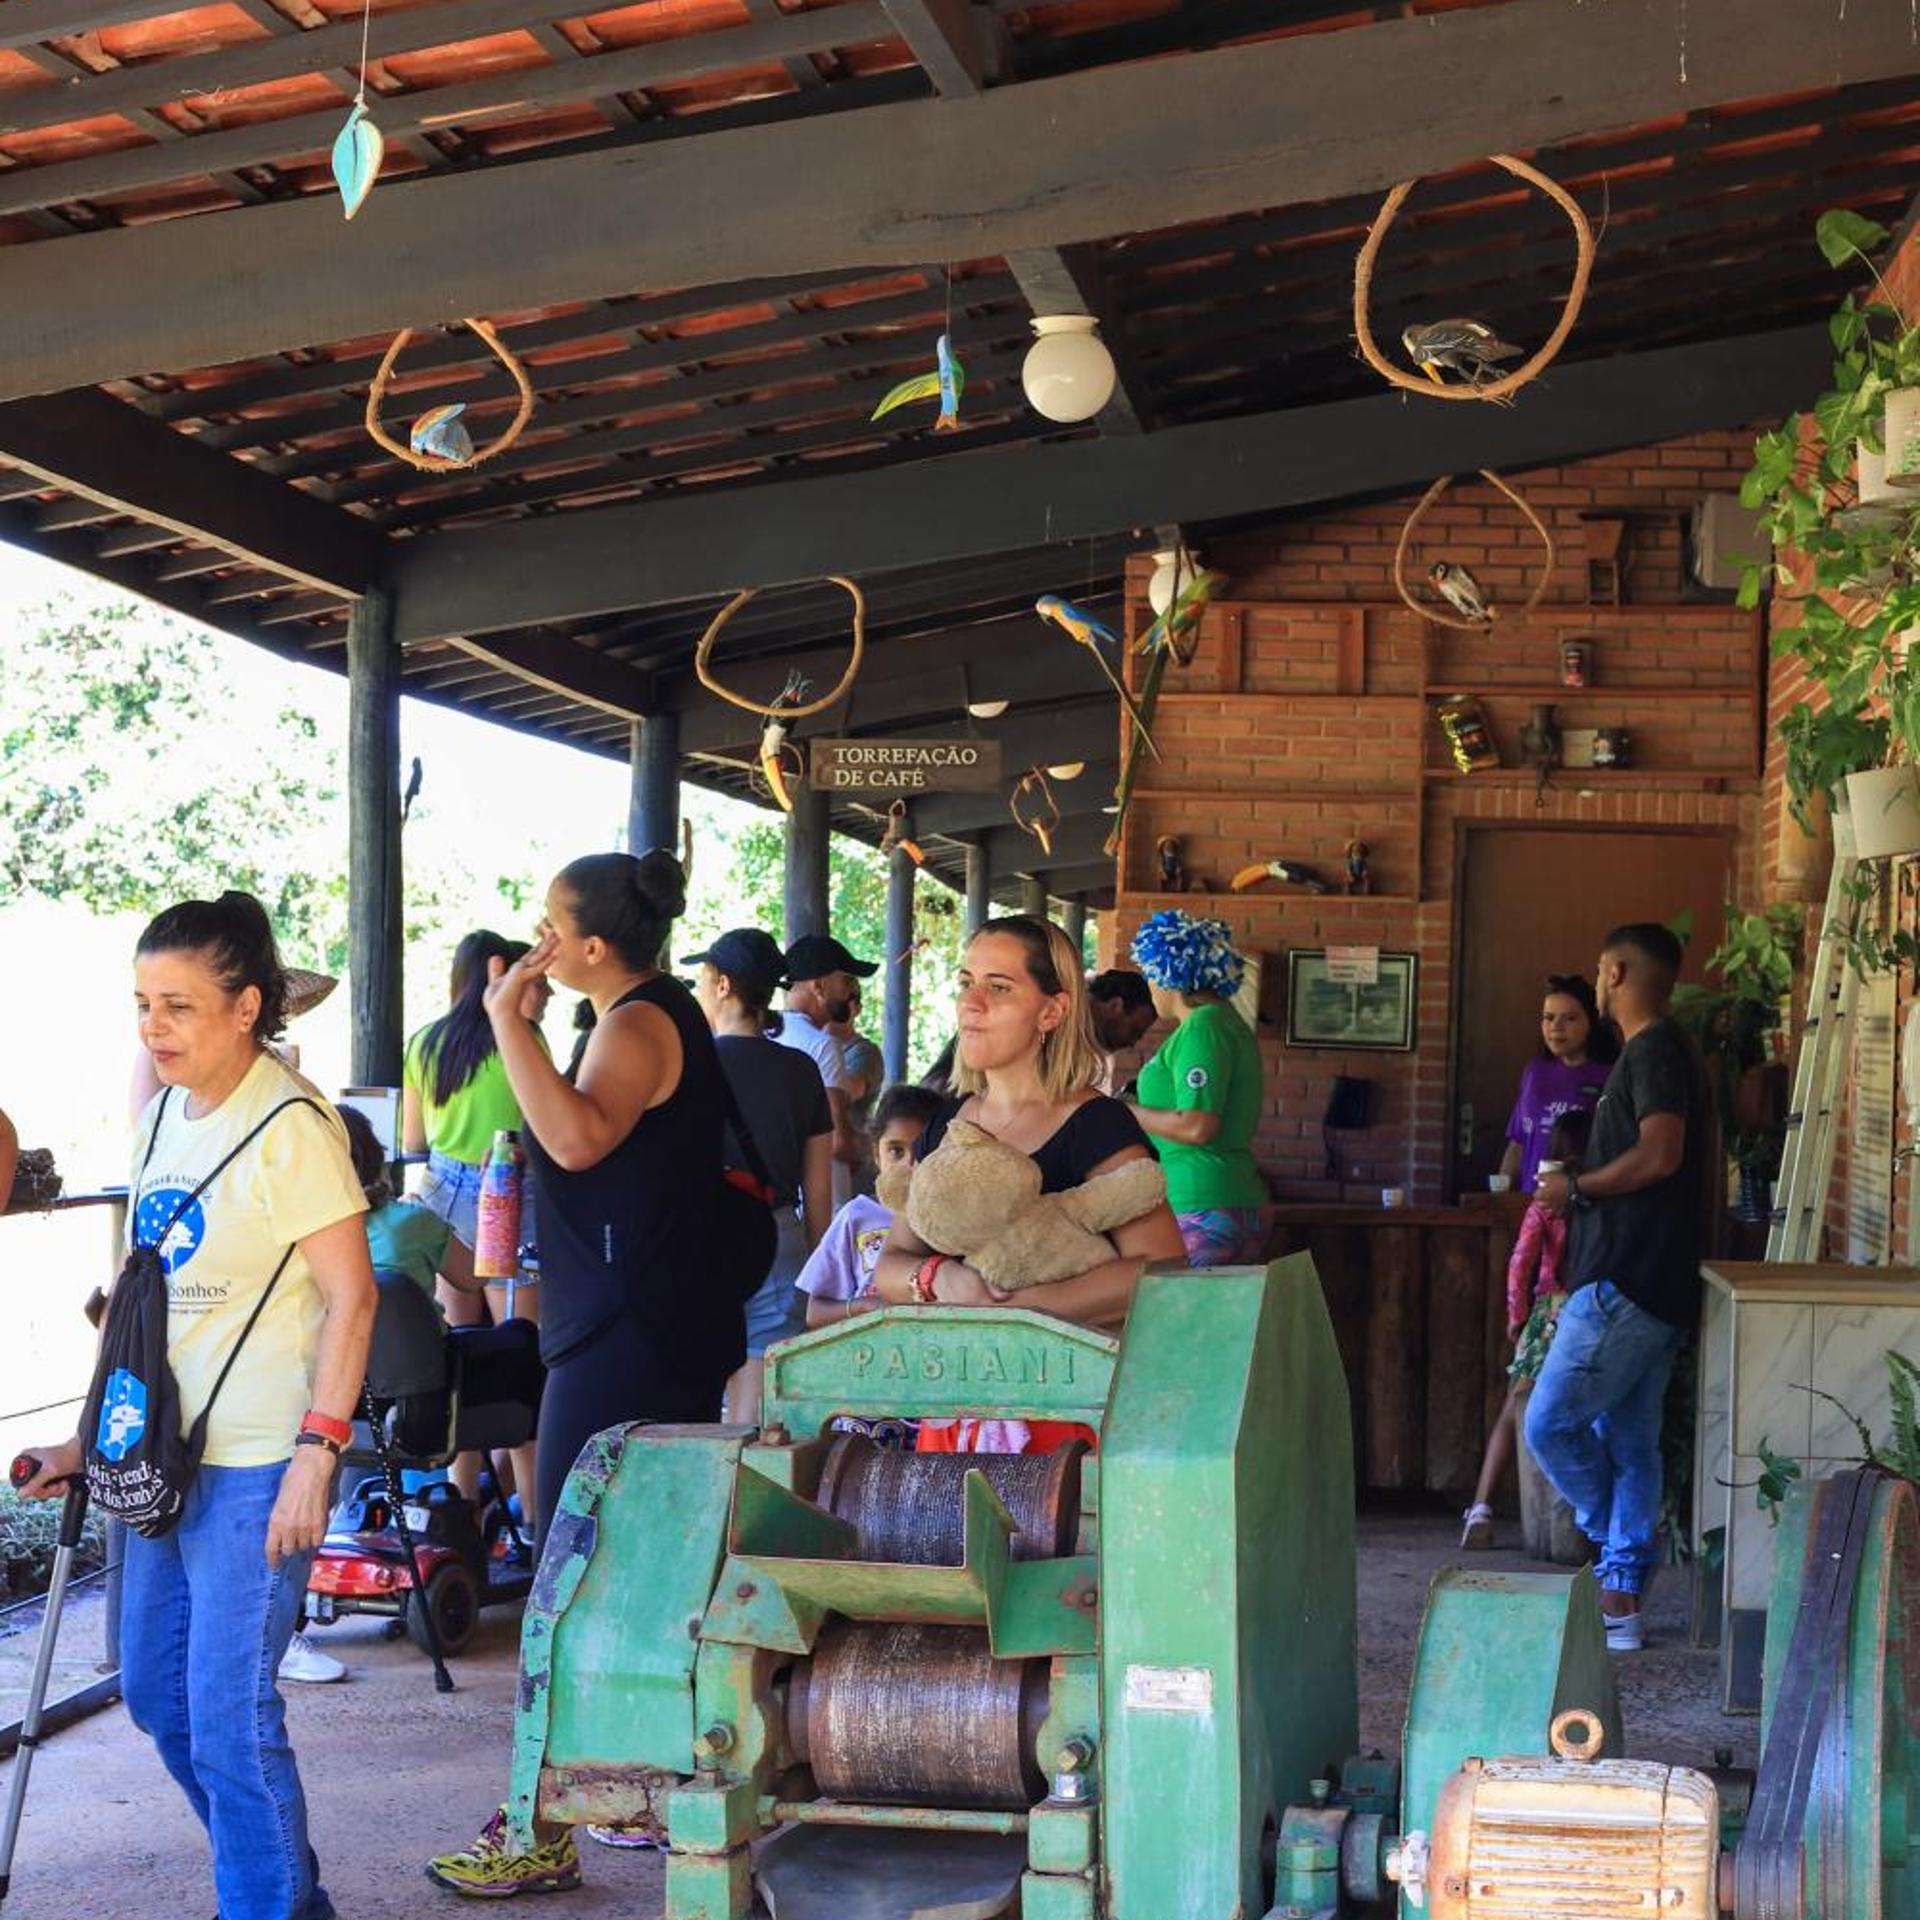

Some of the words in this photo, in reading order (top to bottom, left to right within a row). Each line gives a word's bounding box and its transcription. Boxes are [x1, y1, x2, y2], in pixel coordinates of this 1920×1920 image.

[833, 746, 977, 767] TORREFAÇÃO
[834, 770, 864, 786] DE
[869, 767, 925, 787] CAFÉ
